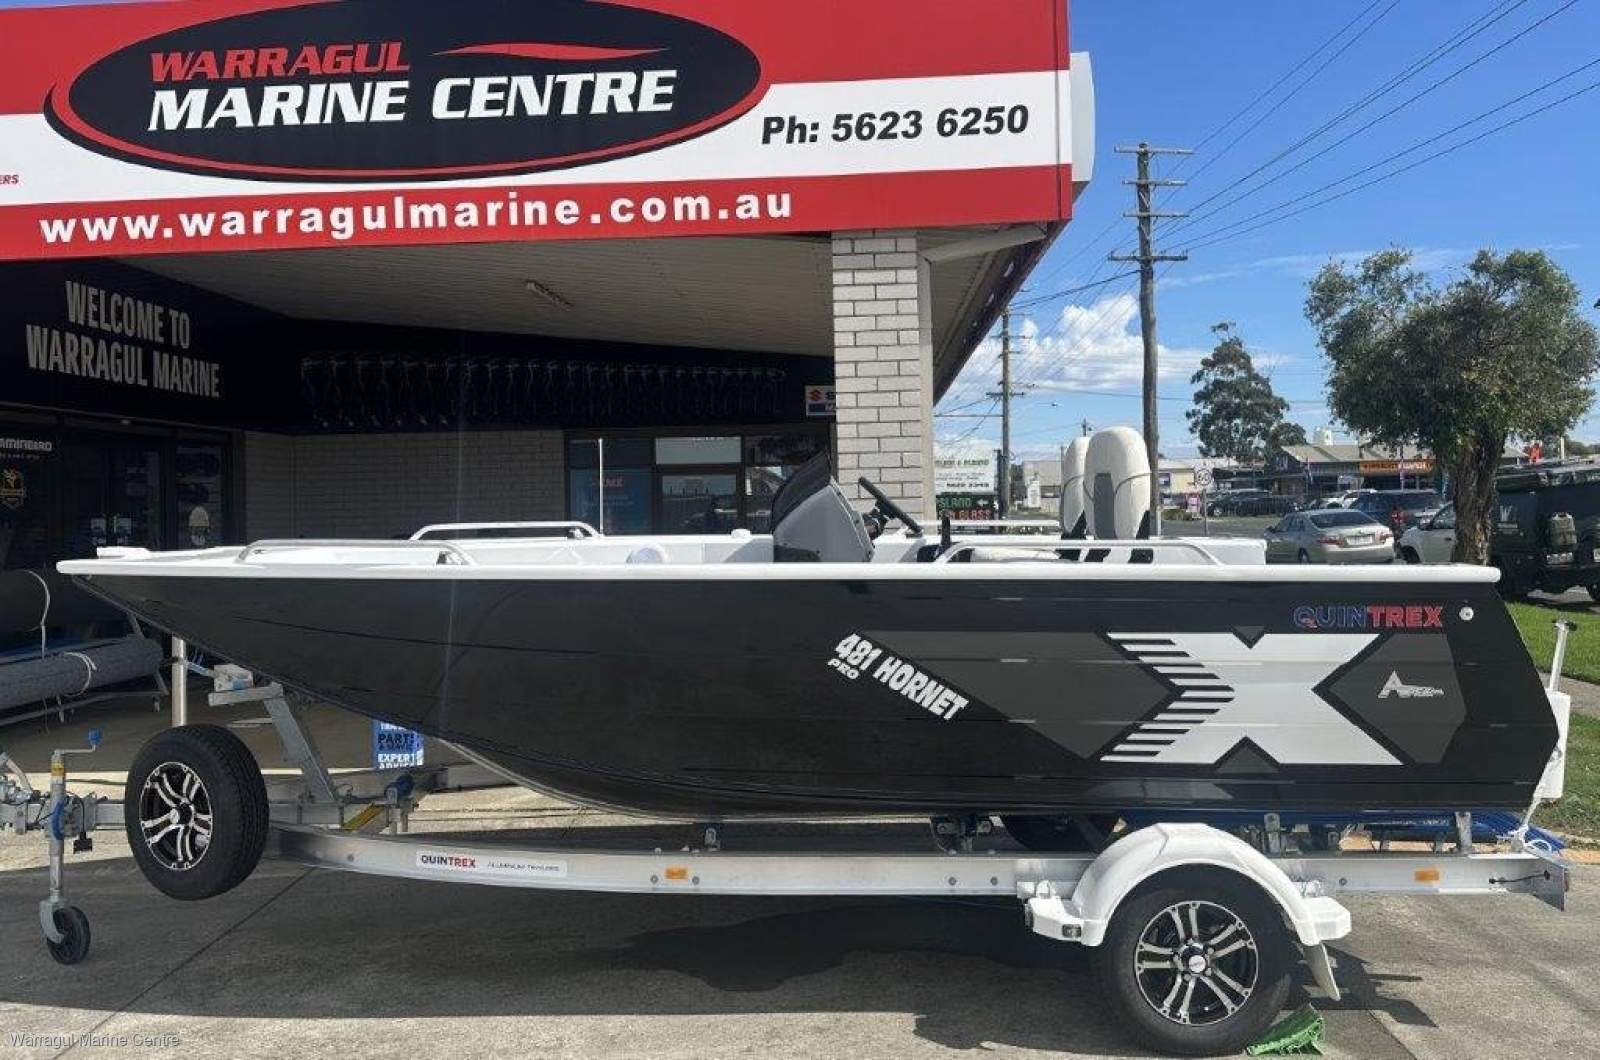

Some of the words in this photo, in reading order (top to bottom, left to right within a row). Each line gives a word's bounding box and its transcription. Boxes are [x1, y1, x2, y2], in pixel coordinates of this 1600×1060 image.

[150, 41, 409, 82] WARRAGUL
[148, 81, 409, 131] MARINE
[432, 69, 677, 120] CENTRE
[762, 115, 820, 145] Ph:
[832, 111, 923, 142] 5623
[936, 104, 1029, 138] 6250
[40, 190, 792, 243] www.warragulmarine.com.au
[65, 280, 164, 345] WELCOME
[168, 308, 191, 350] TO
[26, 324, 148, 387] WARRAGUL
[153, 350, 220, 398] MARINE
[1292, 604, 1444, 629] QUINTREX
[827, 658, 860, 680] PRO
[834, 632, 882, 671] 481
[872, 656, 970, 721] HORNET
[420, 854, 477, 869] QUINTREX
